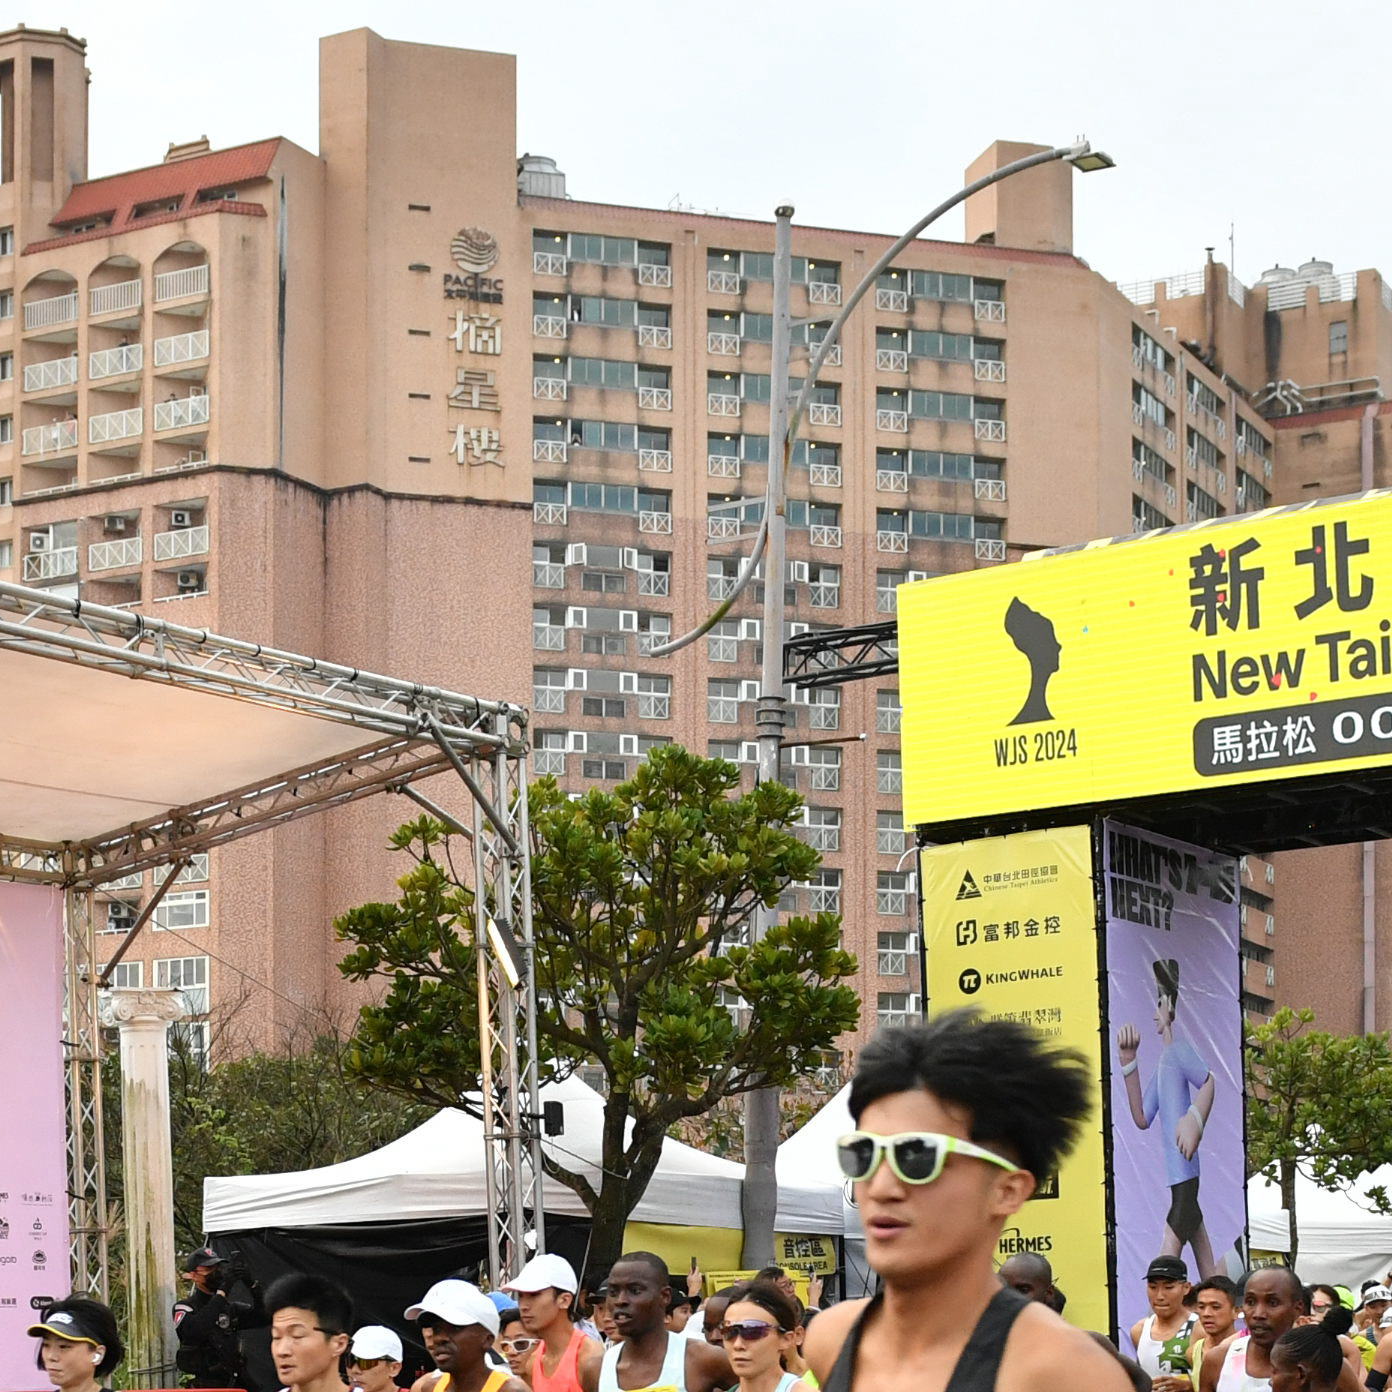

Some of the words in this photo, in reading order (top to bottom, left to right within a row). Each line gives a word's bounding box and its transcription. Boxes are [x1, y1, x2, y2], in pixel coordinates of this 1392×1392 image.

[444, 274, 503, 291] PACIFIC
[447, 310, 505, 467] 摘星樓
[1192, 647, 1306, 703] New
[994, 734, 1029, 768] WJS
[1034, 728, 1078, 761] 2024
[1211, 714, 1316, 767] 馬拉松
[983, 915, 1061, 943] 富邦金控
[986, 966, 1063, 985] KINGWHALE
[783, 1237, 826, 1259] 音控區
[999, 1236, 1052, 1254] HERMES
